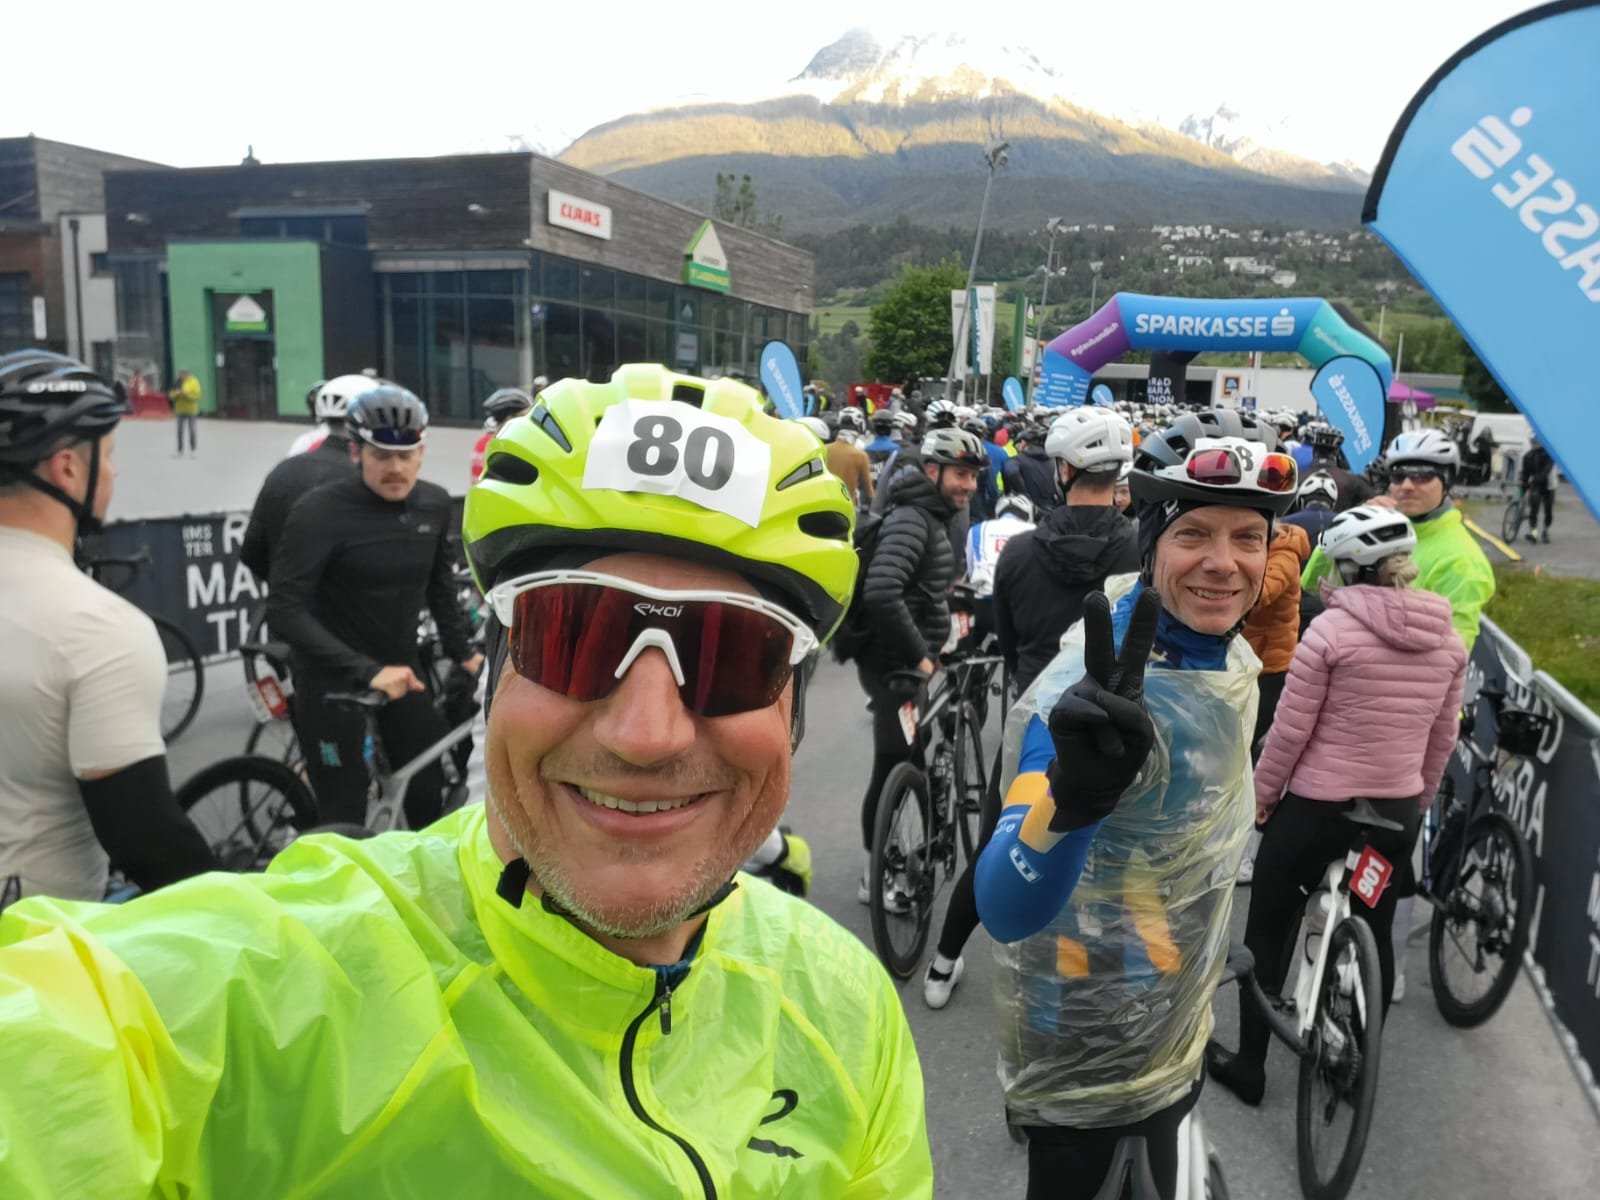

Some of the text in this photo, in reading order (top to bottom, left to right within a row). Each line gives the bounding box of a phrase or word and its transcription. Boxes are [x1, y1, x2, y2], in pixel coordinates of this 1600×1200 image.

[560, 203, 601, 228] CLAAS
[1135, 313, 1268, 337] SPARKASSE
[1151, 377, 1172, 387] RAD
[626, 414, 735, 491] 80
[182, 524, 213, 541] IMS
[185, 541, 214, 559] TER
[187, 559, 269, 609] MA
[1358, 856, 1385, 898] 901
